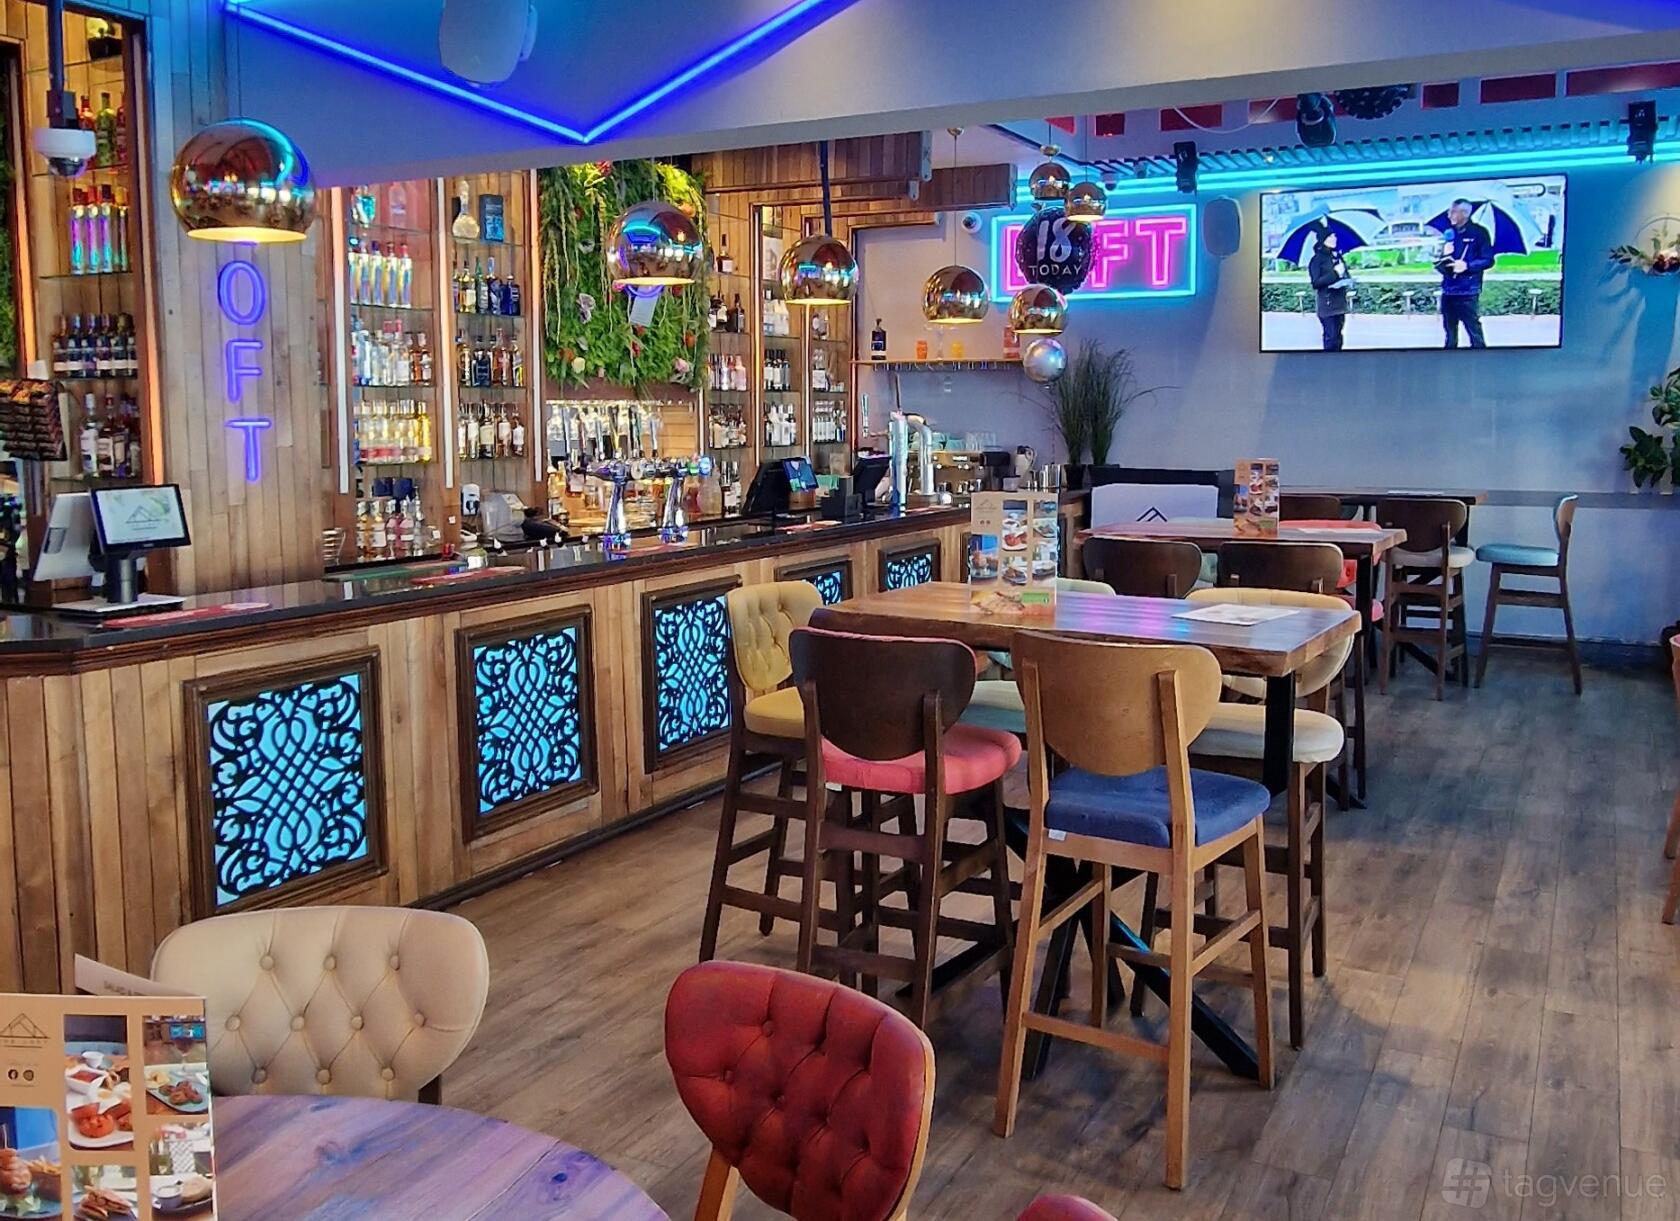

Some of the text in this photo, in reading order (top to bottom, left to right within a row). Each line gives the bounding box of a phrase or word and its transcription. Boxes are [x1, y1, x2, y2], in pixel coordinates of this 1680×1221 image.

[1037, 217, 1077, 262] 18
[1028, 263, 1082, 276] TODAY
[217, 241, 272, 482] OFT
